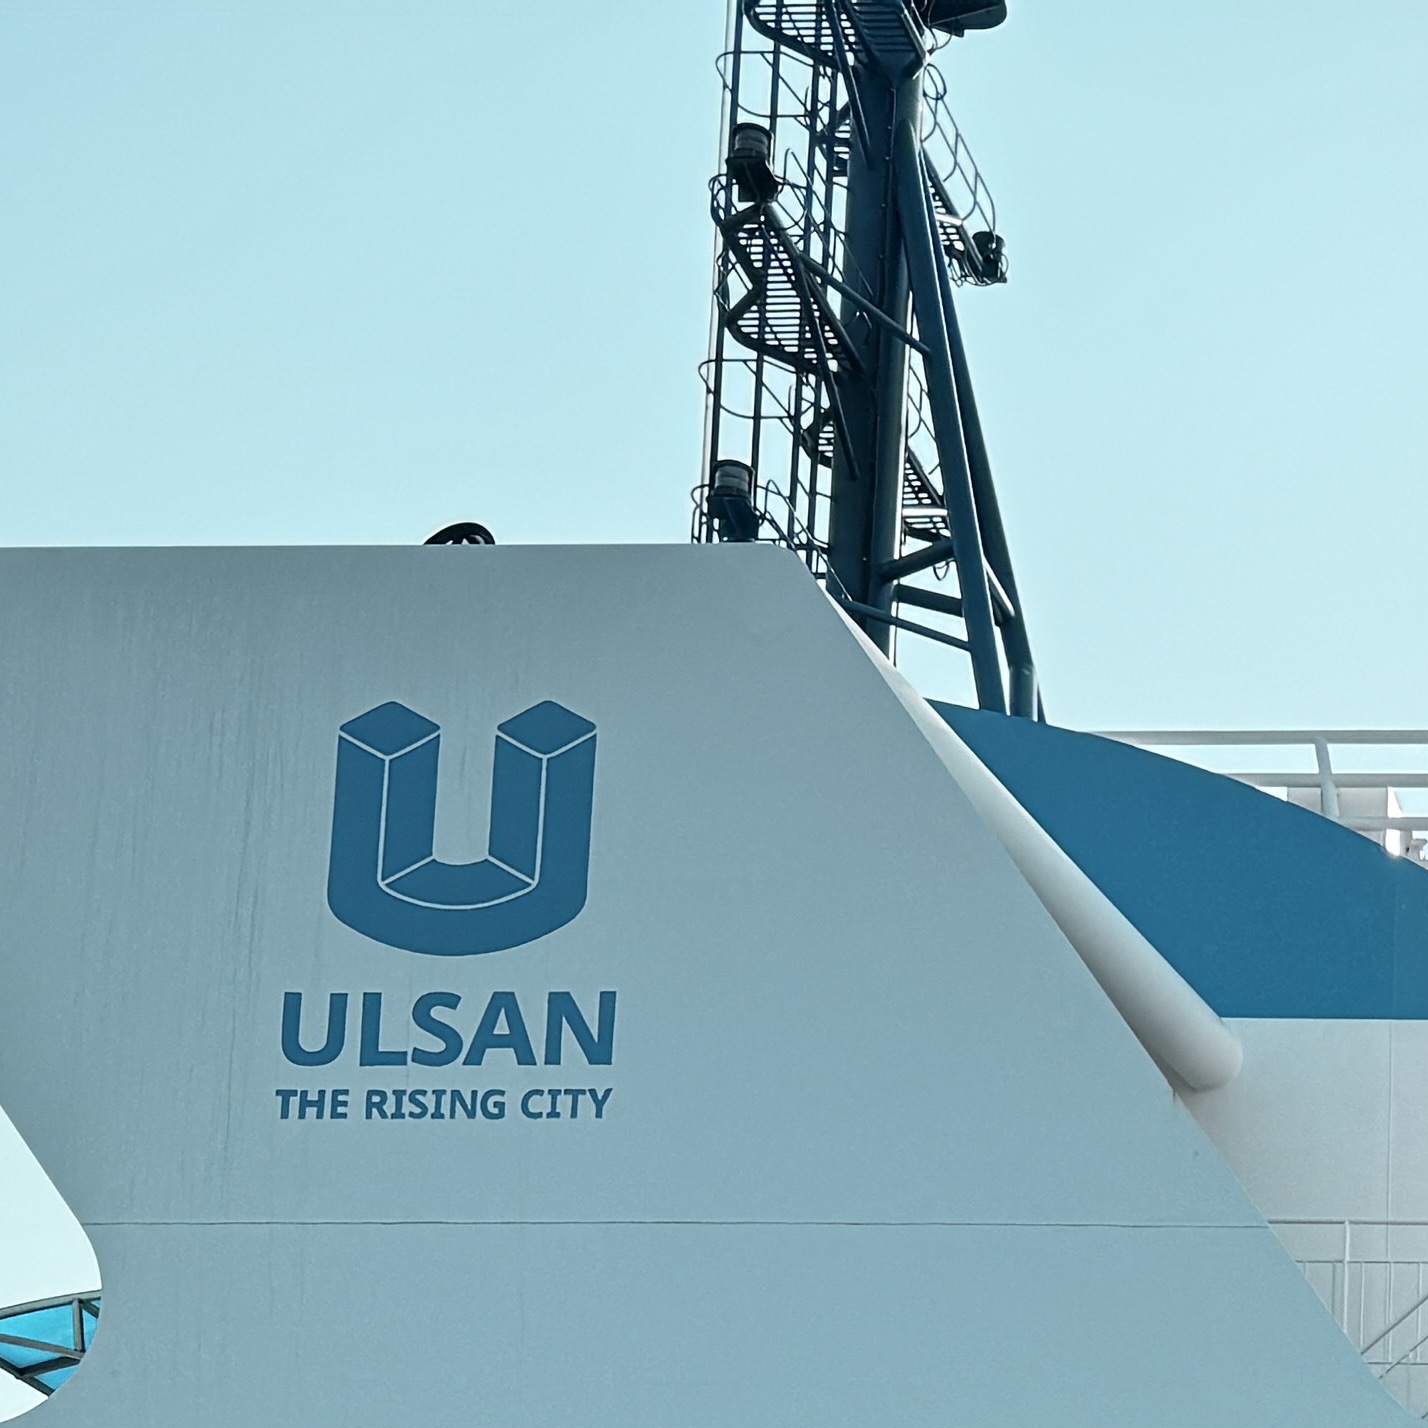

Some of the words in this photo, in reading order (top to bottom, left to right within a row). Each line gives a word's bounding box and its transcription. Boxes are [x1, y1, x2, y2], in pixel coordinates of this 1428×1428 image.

[281, 990, 618, 1068] ULSAN
[275, 1088, 350, 1120] THE
[365, 1088, 506, 1121] RISING
[520, 1087, 613, 1120] CITY
